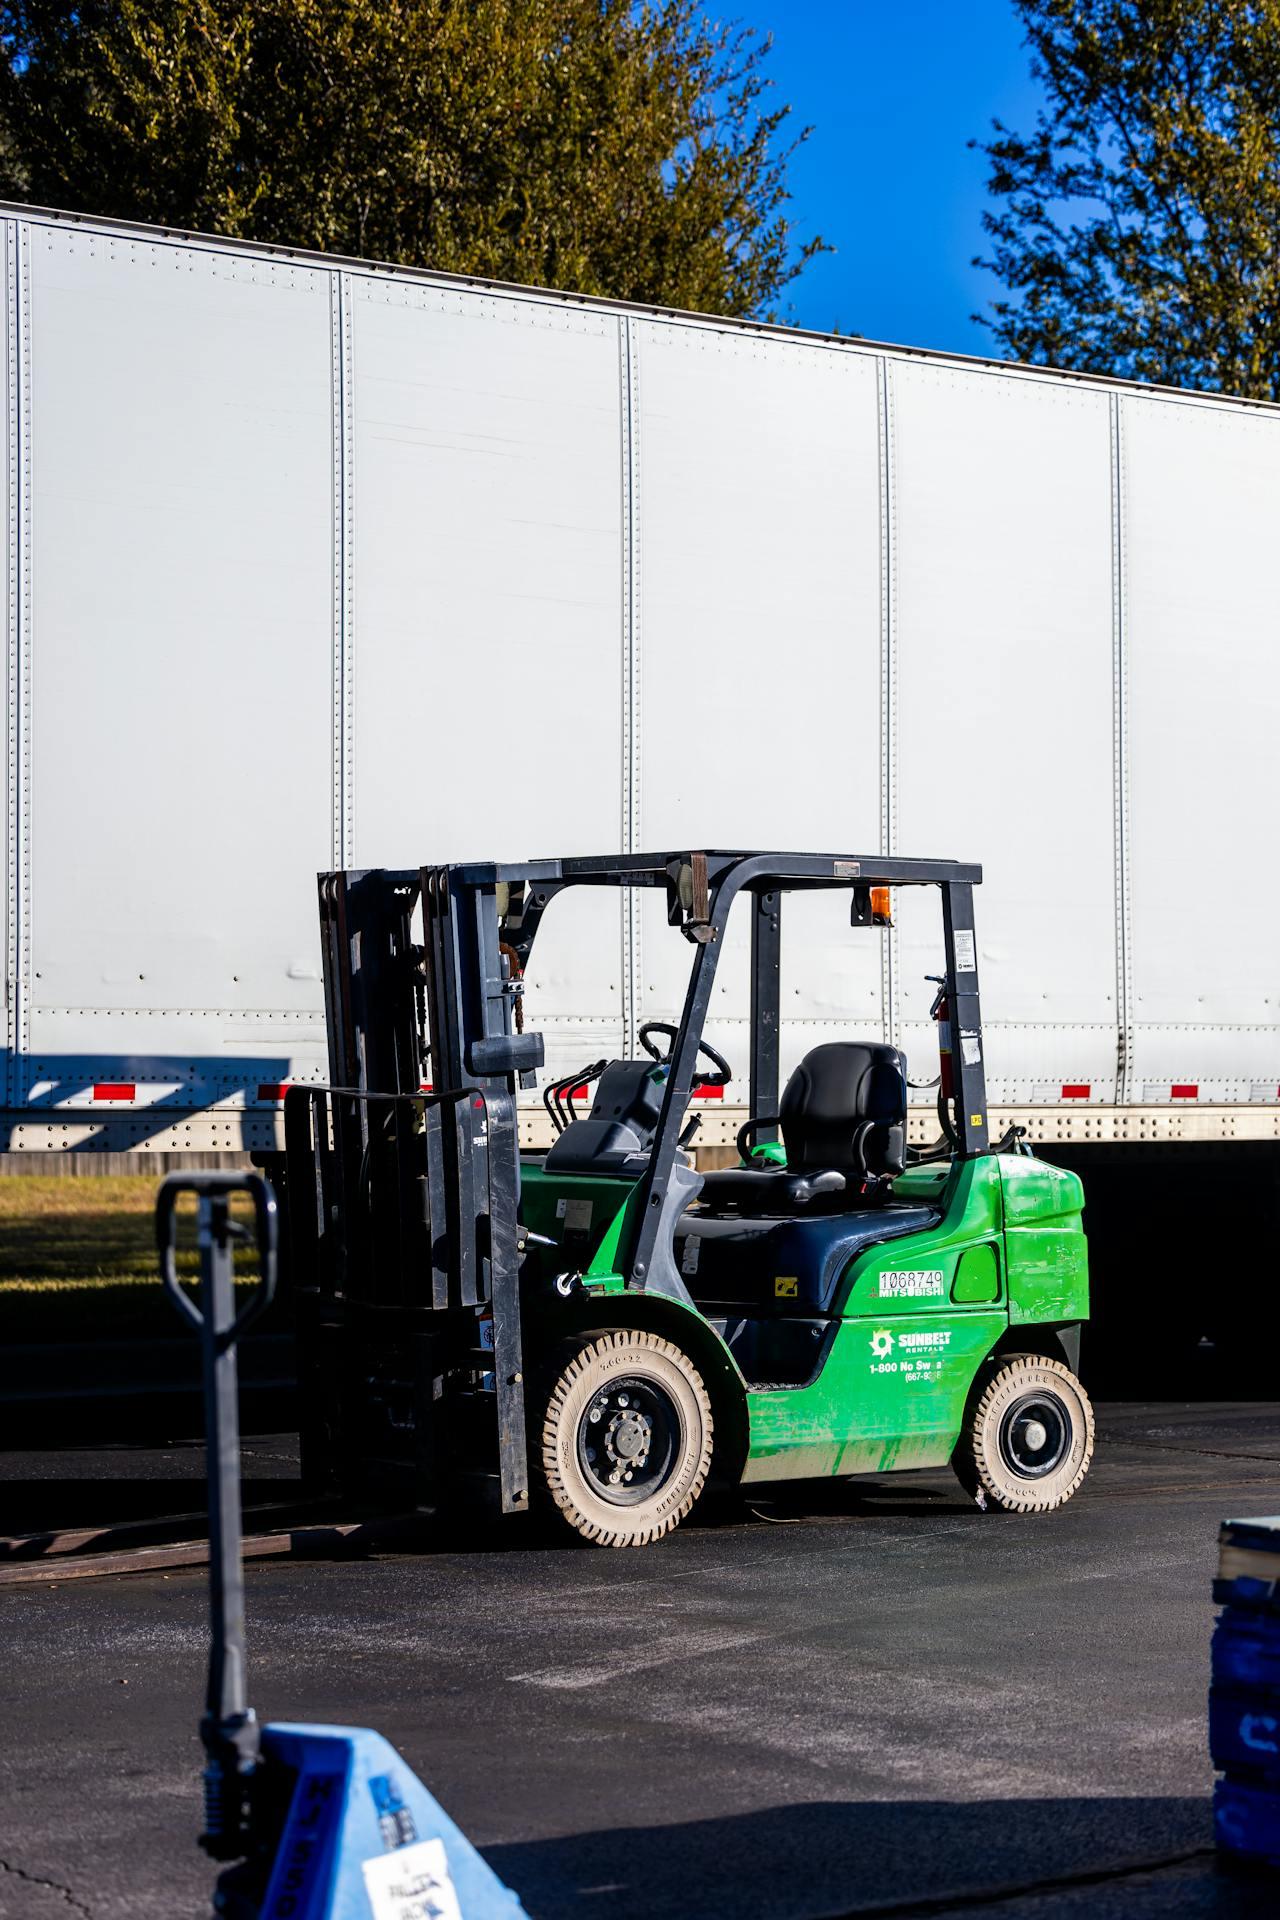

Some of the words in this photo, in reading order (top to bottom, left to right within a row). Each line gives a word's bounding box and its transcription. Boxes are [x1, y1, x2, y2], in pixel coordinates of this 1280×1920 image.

[881, 1272, 942, 1289] 1068749
[879, 1287, 945, 1298] MITSUBISHI
[898, 1332, 952, 1348] SUNBELT
[905, 1346, 944, 1354] RENTALS
[869, 1362, 898, 1375] 1-800
[900, 1361, 914, 1372] No
